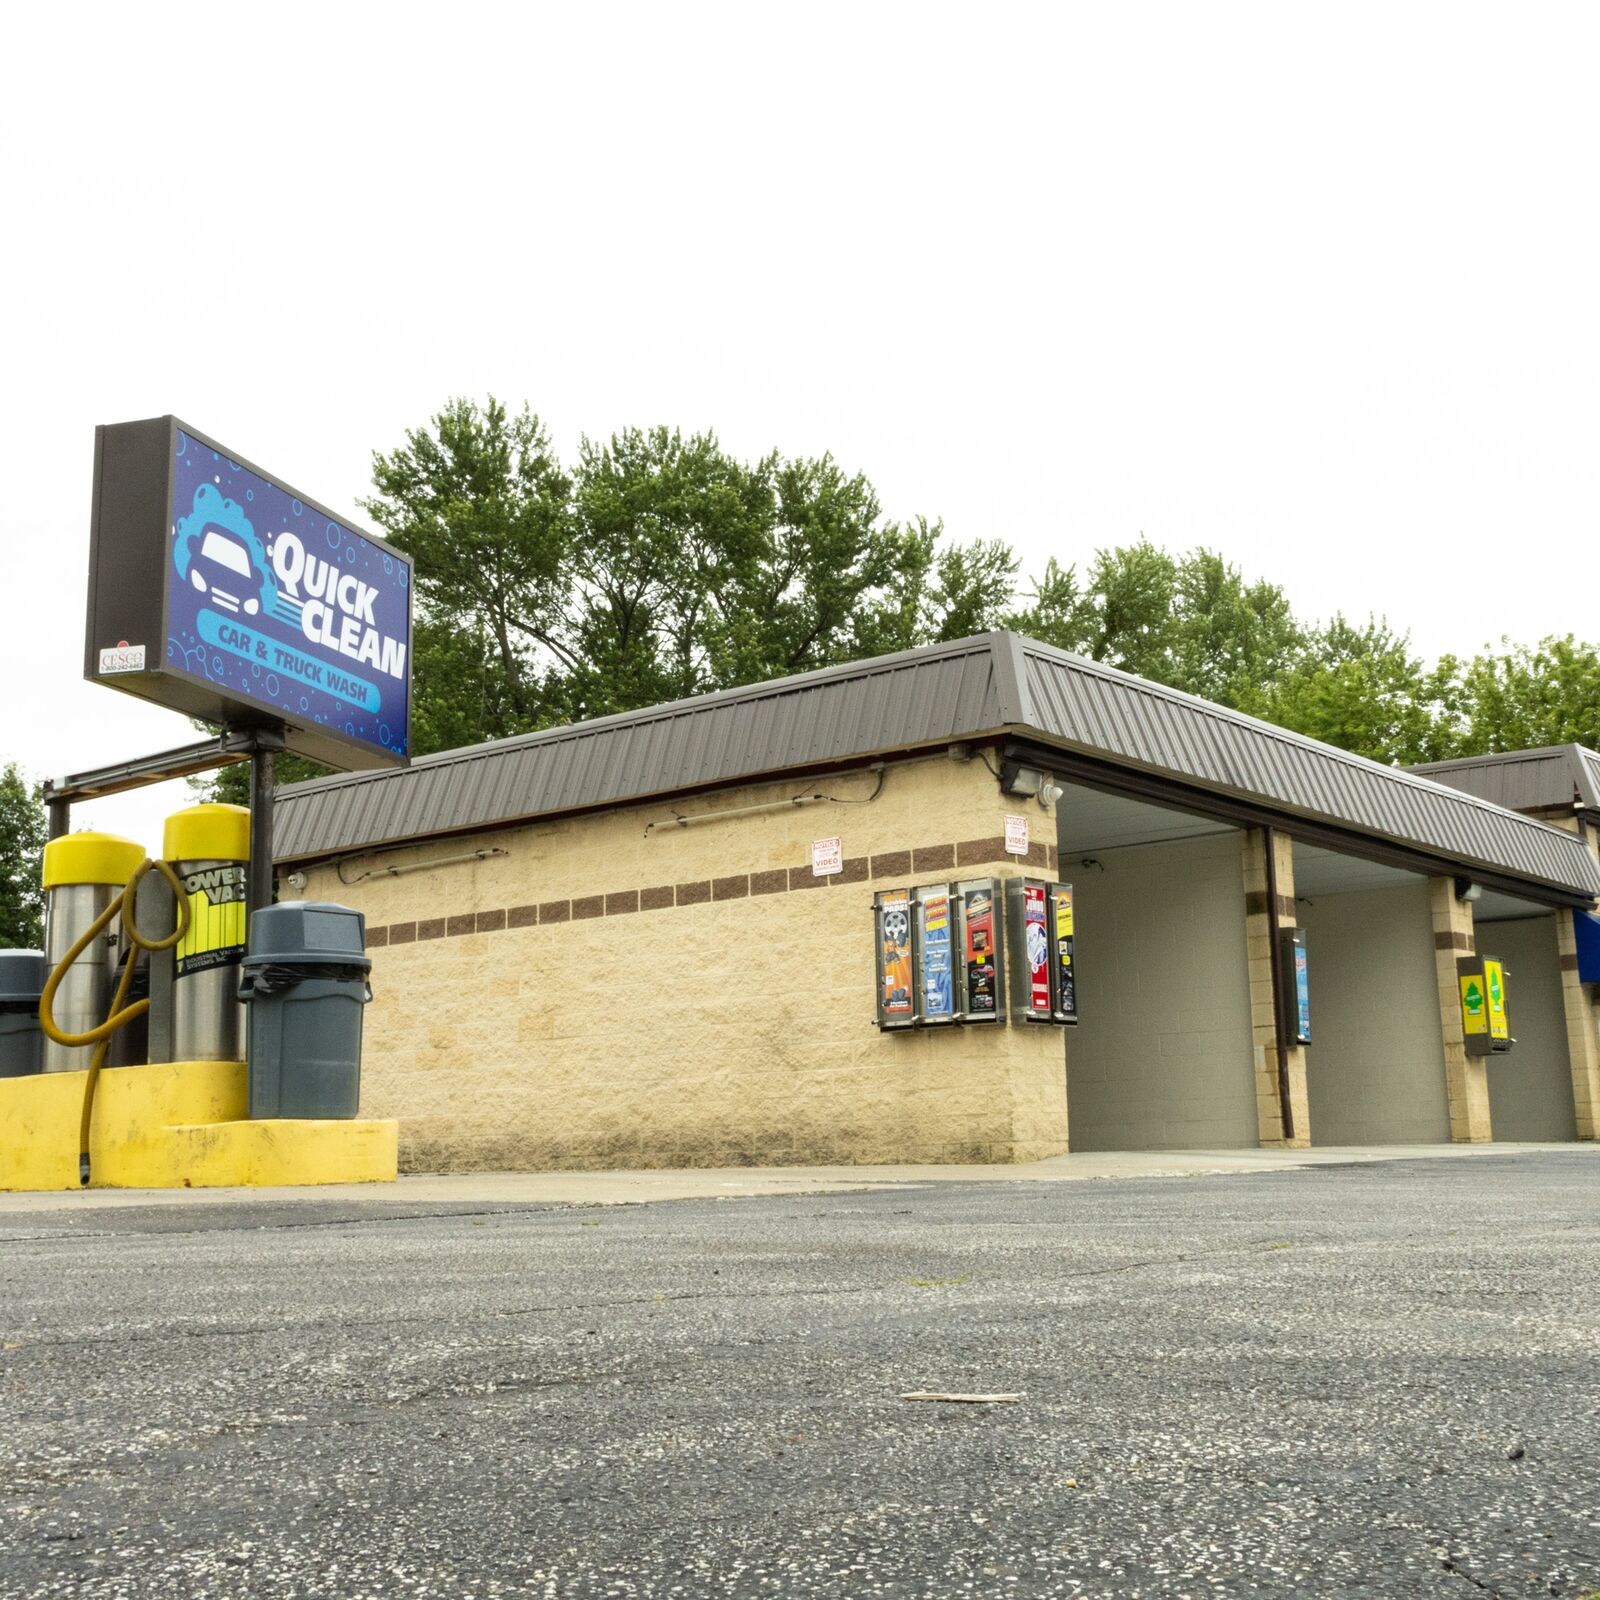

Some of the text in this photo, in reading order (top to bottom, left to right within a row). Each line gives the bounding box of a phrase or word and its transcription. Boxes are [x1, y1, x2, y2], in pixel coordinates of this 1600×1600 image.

[273, 532, 379, 626] QUICK
[301, 599, 406, 680] CLEAN
[102, 652, 143, 667] CESCO
[218, 624, 367, 704] CAR & TRUCK WASH
[1008, 837, 1026, 846] VIDEO
[815, 857, 839, 867] VIDEO
[205, 882, 246, 904] VAC
